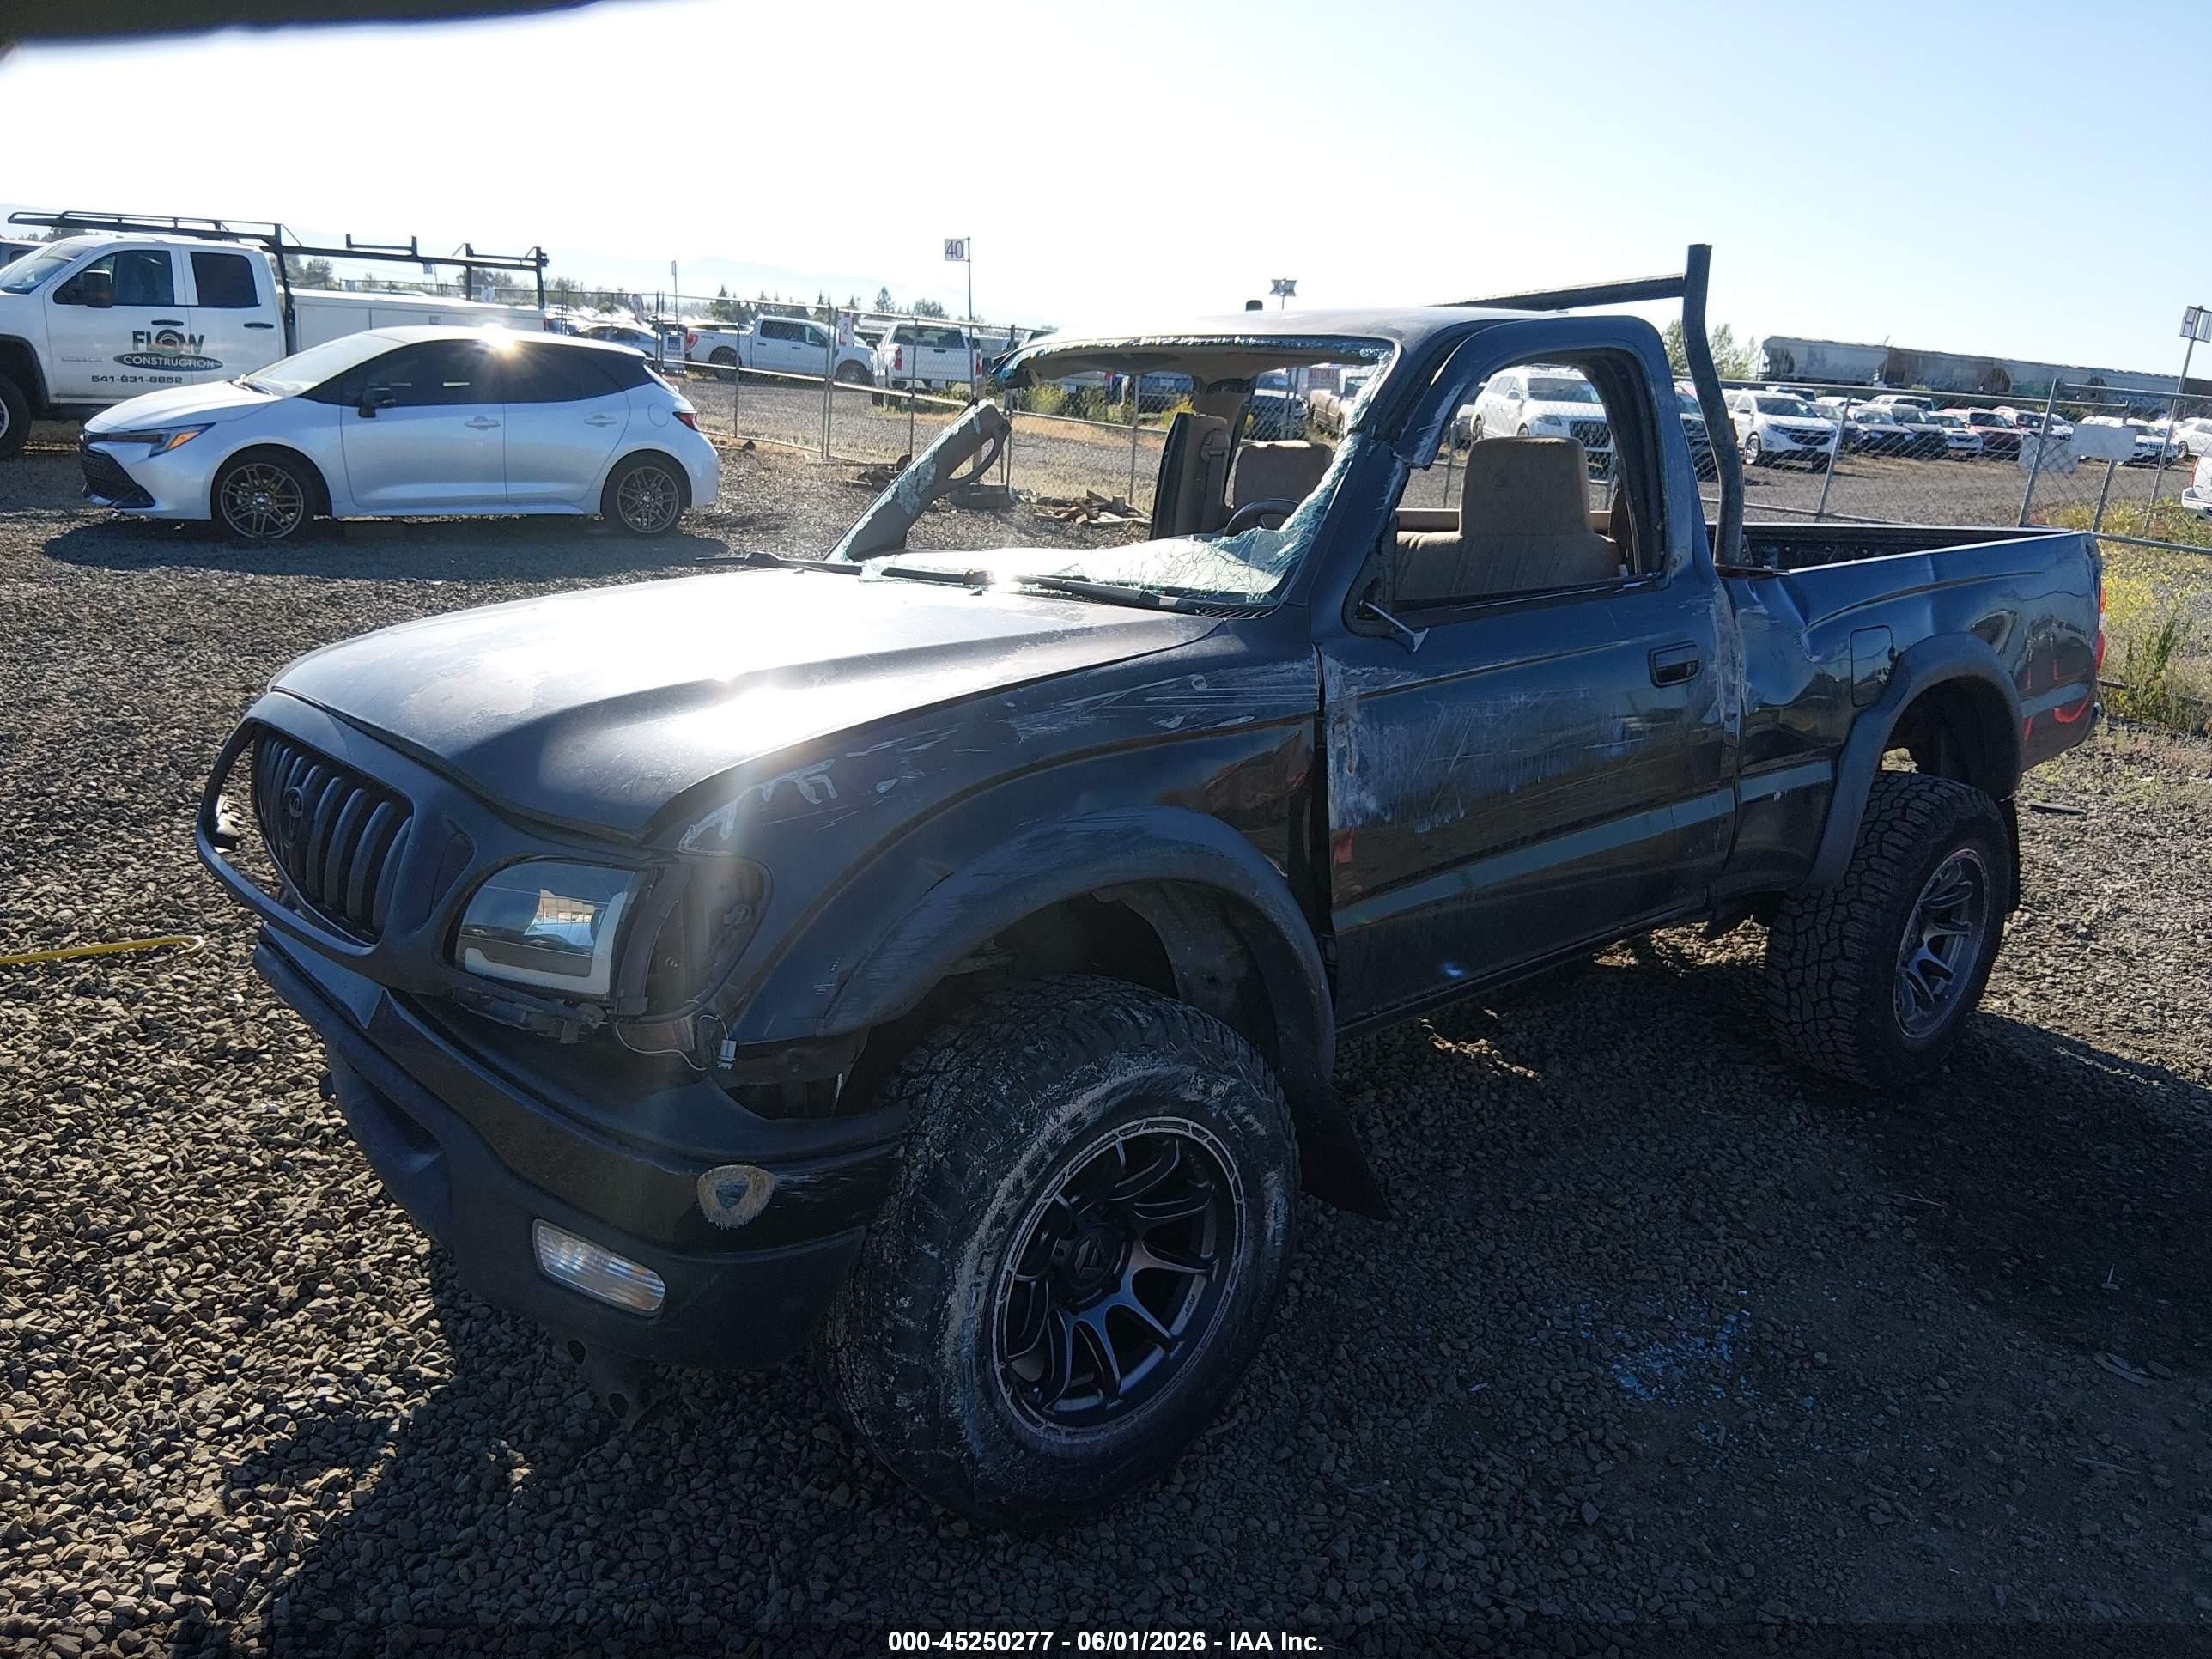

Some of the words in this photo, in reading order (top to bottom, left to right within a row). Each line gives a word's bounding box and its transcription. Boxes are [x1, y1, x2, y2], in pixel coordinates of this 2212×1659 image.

[945, 240, 963, 258] 40
[132, 329, 204, 354] FLOW
[123, 355, 216, 370] CONSTRUCTION
